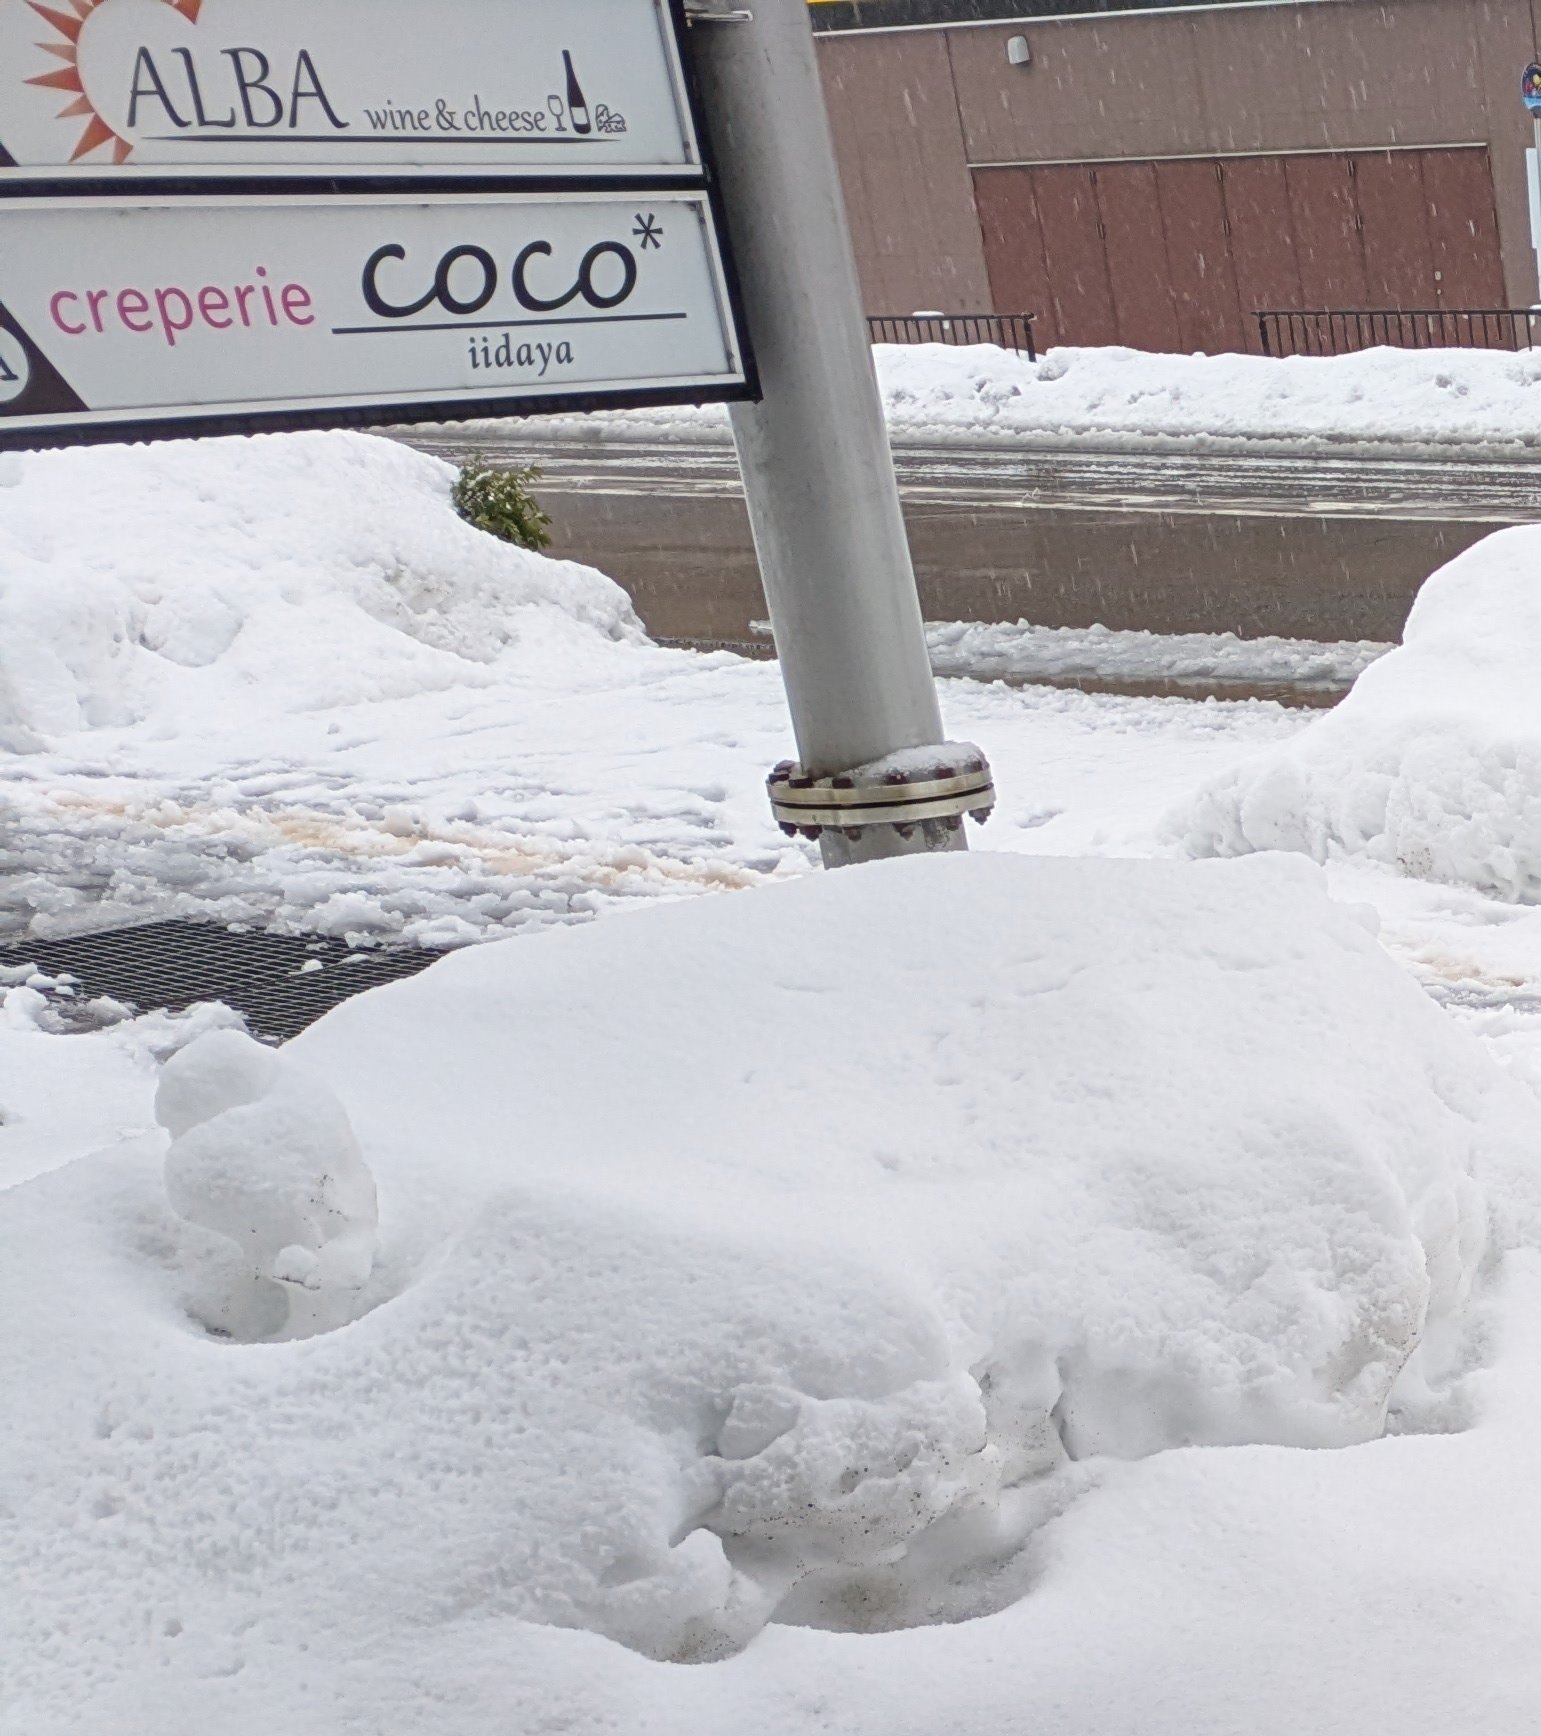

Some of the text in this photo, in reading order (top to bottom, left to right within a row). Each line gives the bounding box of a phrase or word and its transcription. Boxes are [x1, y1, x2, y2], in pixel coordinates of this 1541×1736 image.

[127, 45, 350, 129] ALBA
[49, 266, 316, 347] creperie
[467, 334, 575, 376] iidaya
